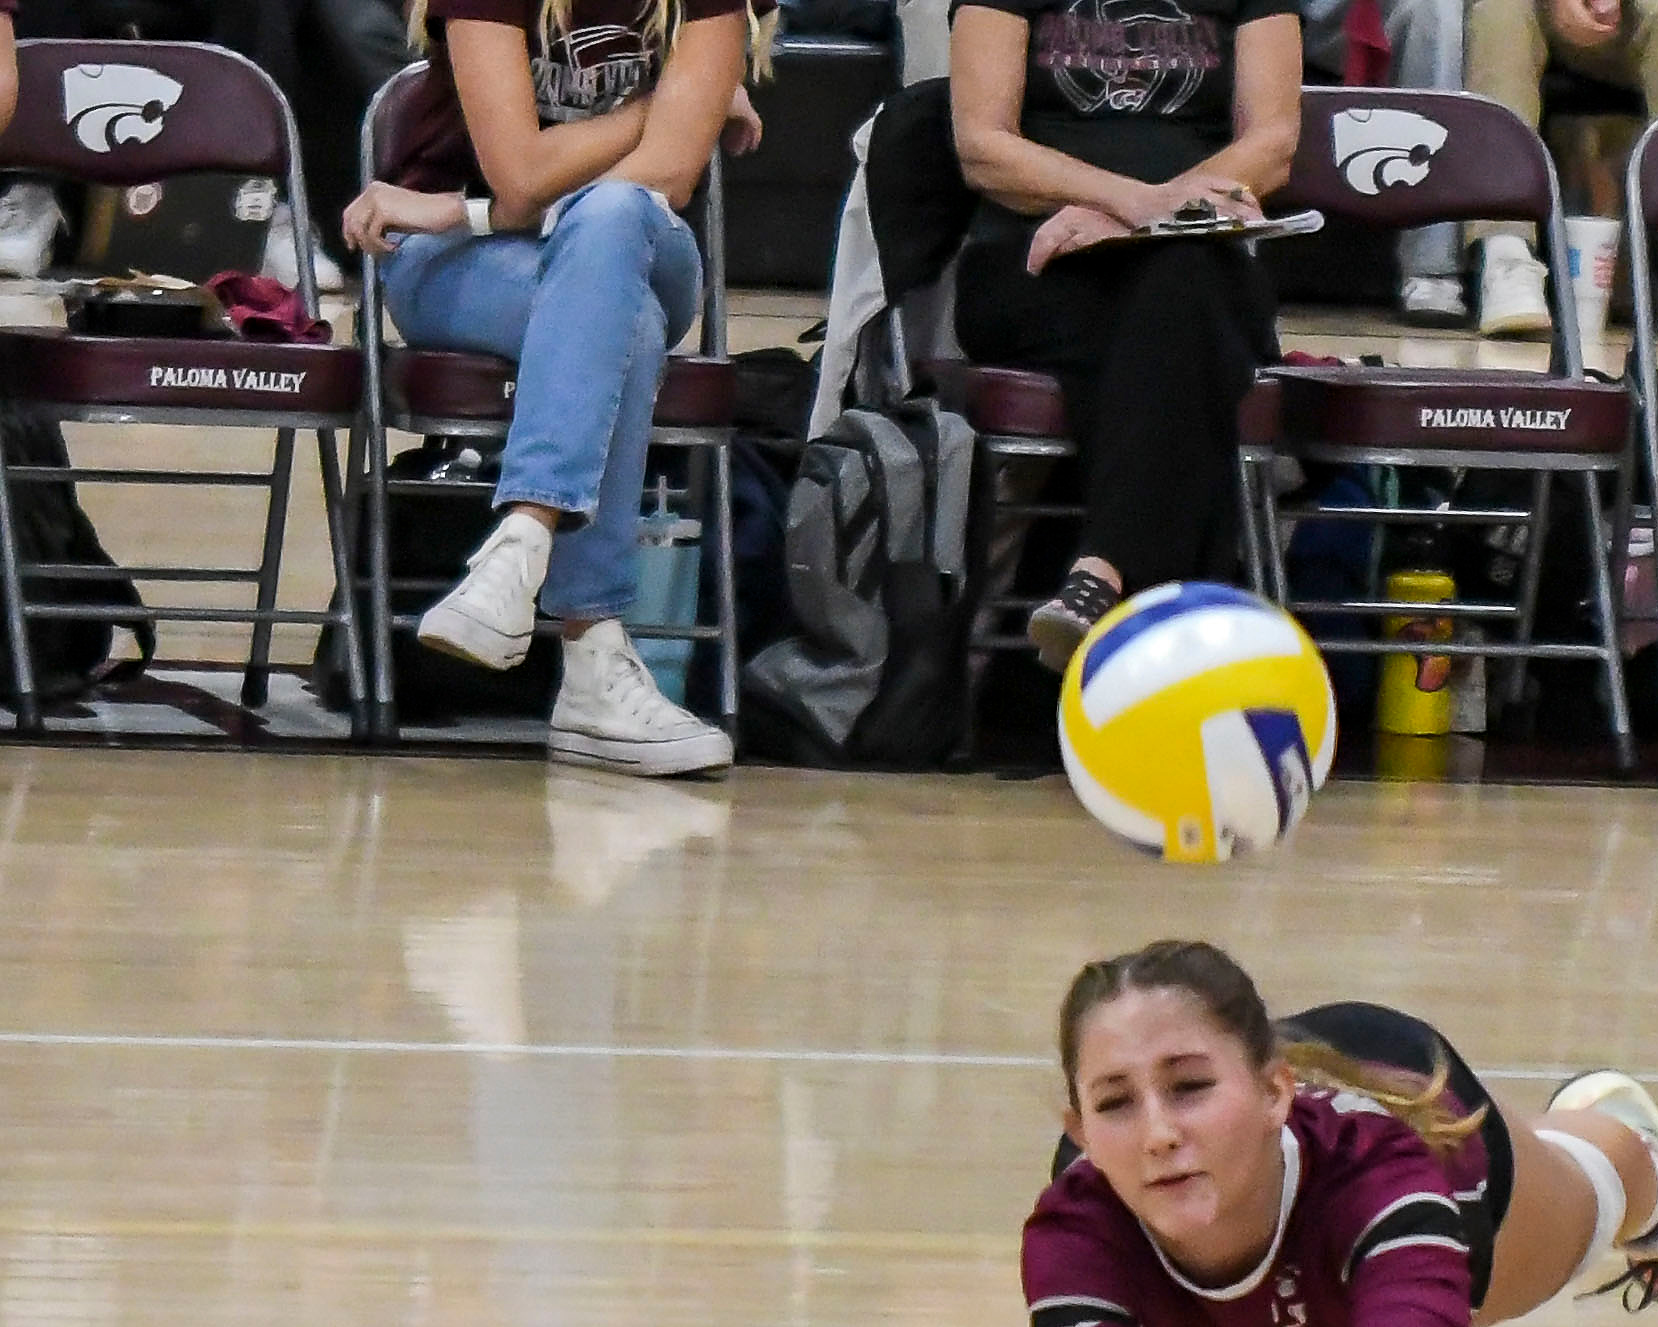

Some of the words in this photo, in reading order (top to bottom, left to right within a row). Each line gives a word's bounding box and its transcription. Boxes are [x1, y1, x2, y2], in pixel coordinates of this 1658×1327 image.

[150, 366, 228, 388] PALOMA
[232, 368, 307, 393] VALLEY
[1421, 408, 1496, 428] PALOMA
[1500, 407, 1572, 430] VALLEY
